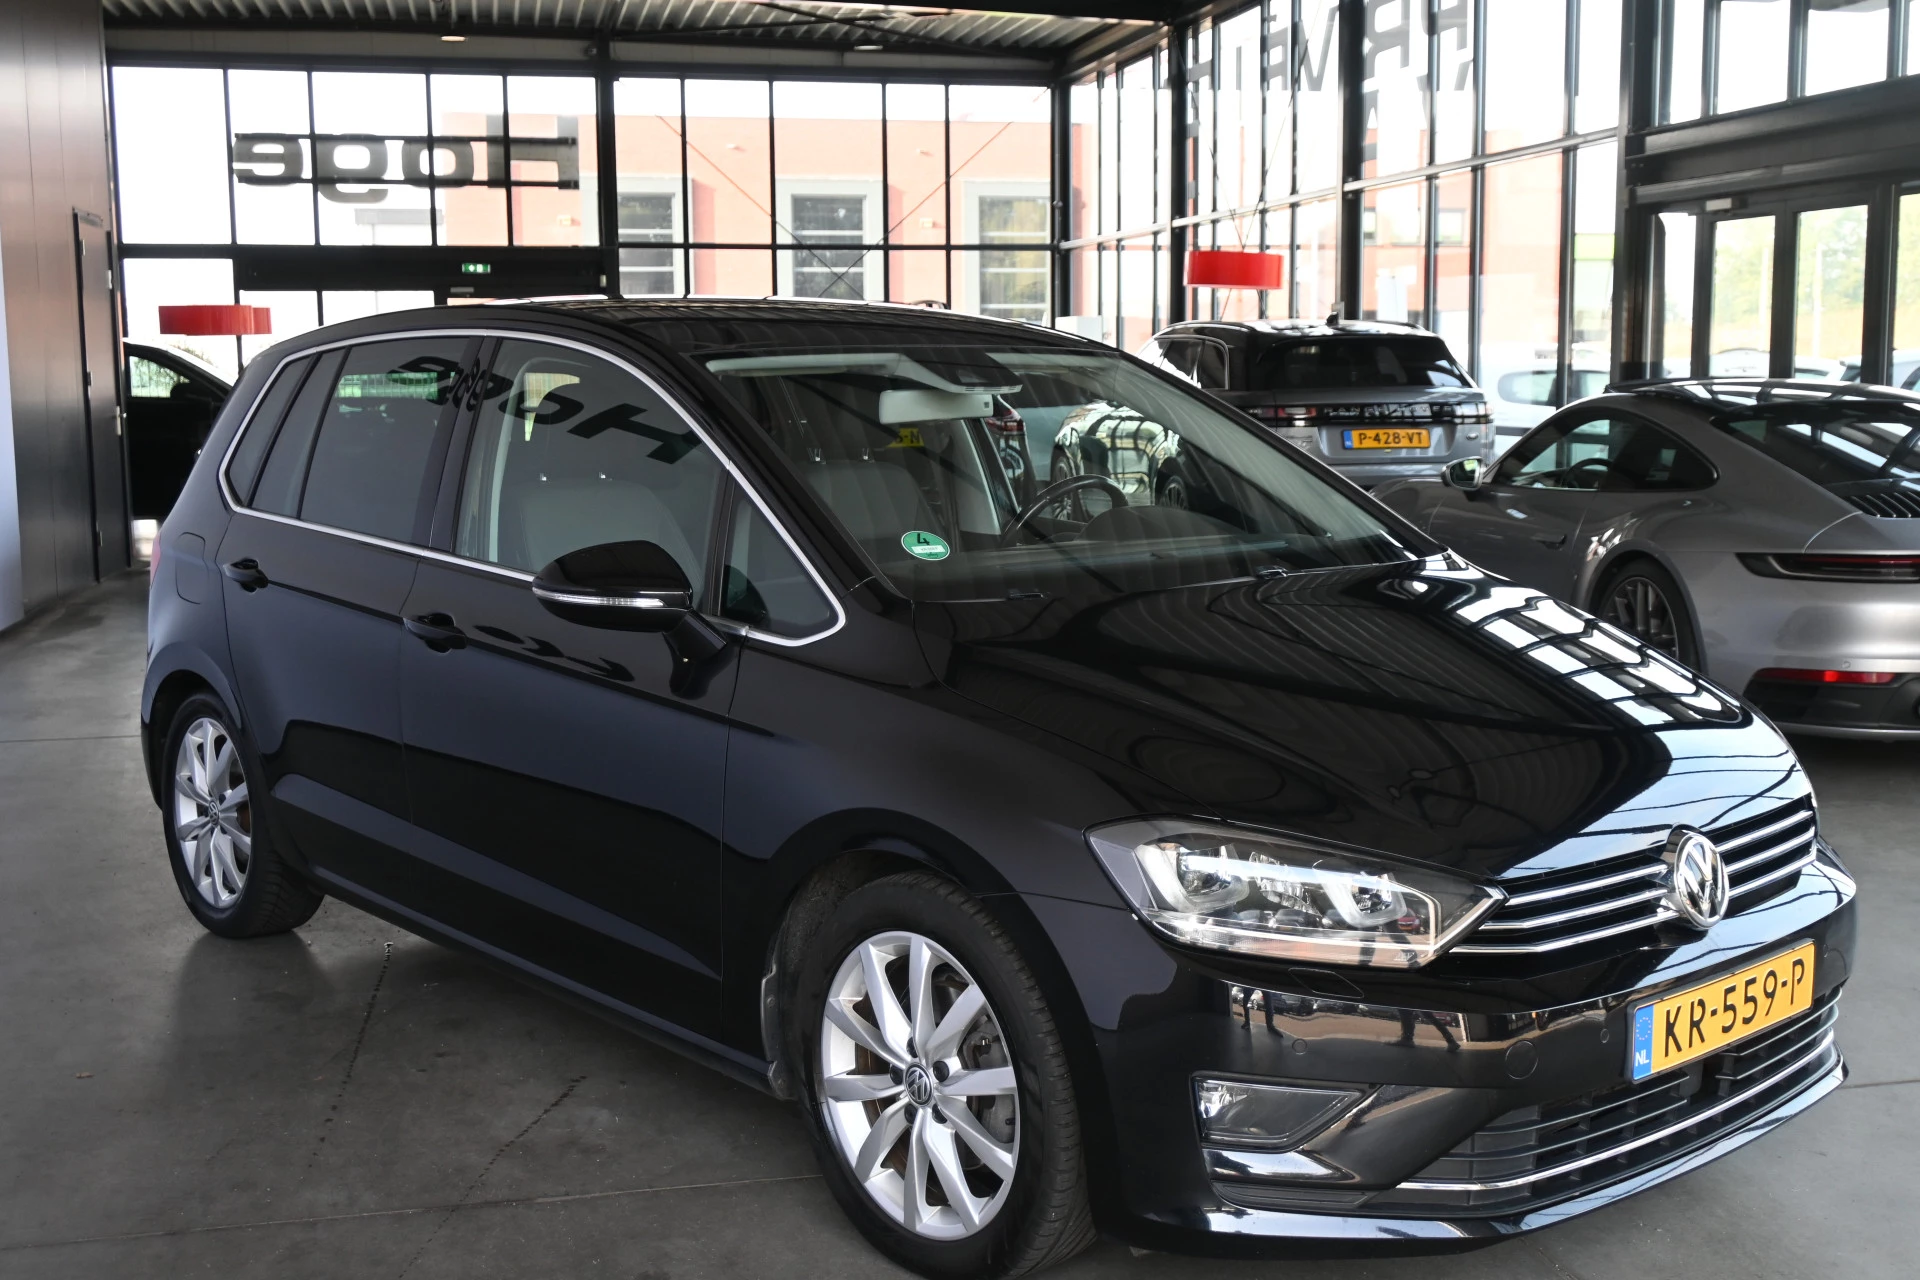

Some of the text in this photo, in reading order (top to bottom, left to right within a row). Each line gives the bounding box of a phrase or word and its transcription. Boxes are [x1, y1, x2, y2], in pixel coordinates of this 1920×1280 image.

[1358, 431, 1423, 445] P-428-VT
[916, 532, 930, 545] 4
[1664, 957, 1805, 1057] KR-559-P
[1635, 1049, 1650, 1066] NL
